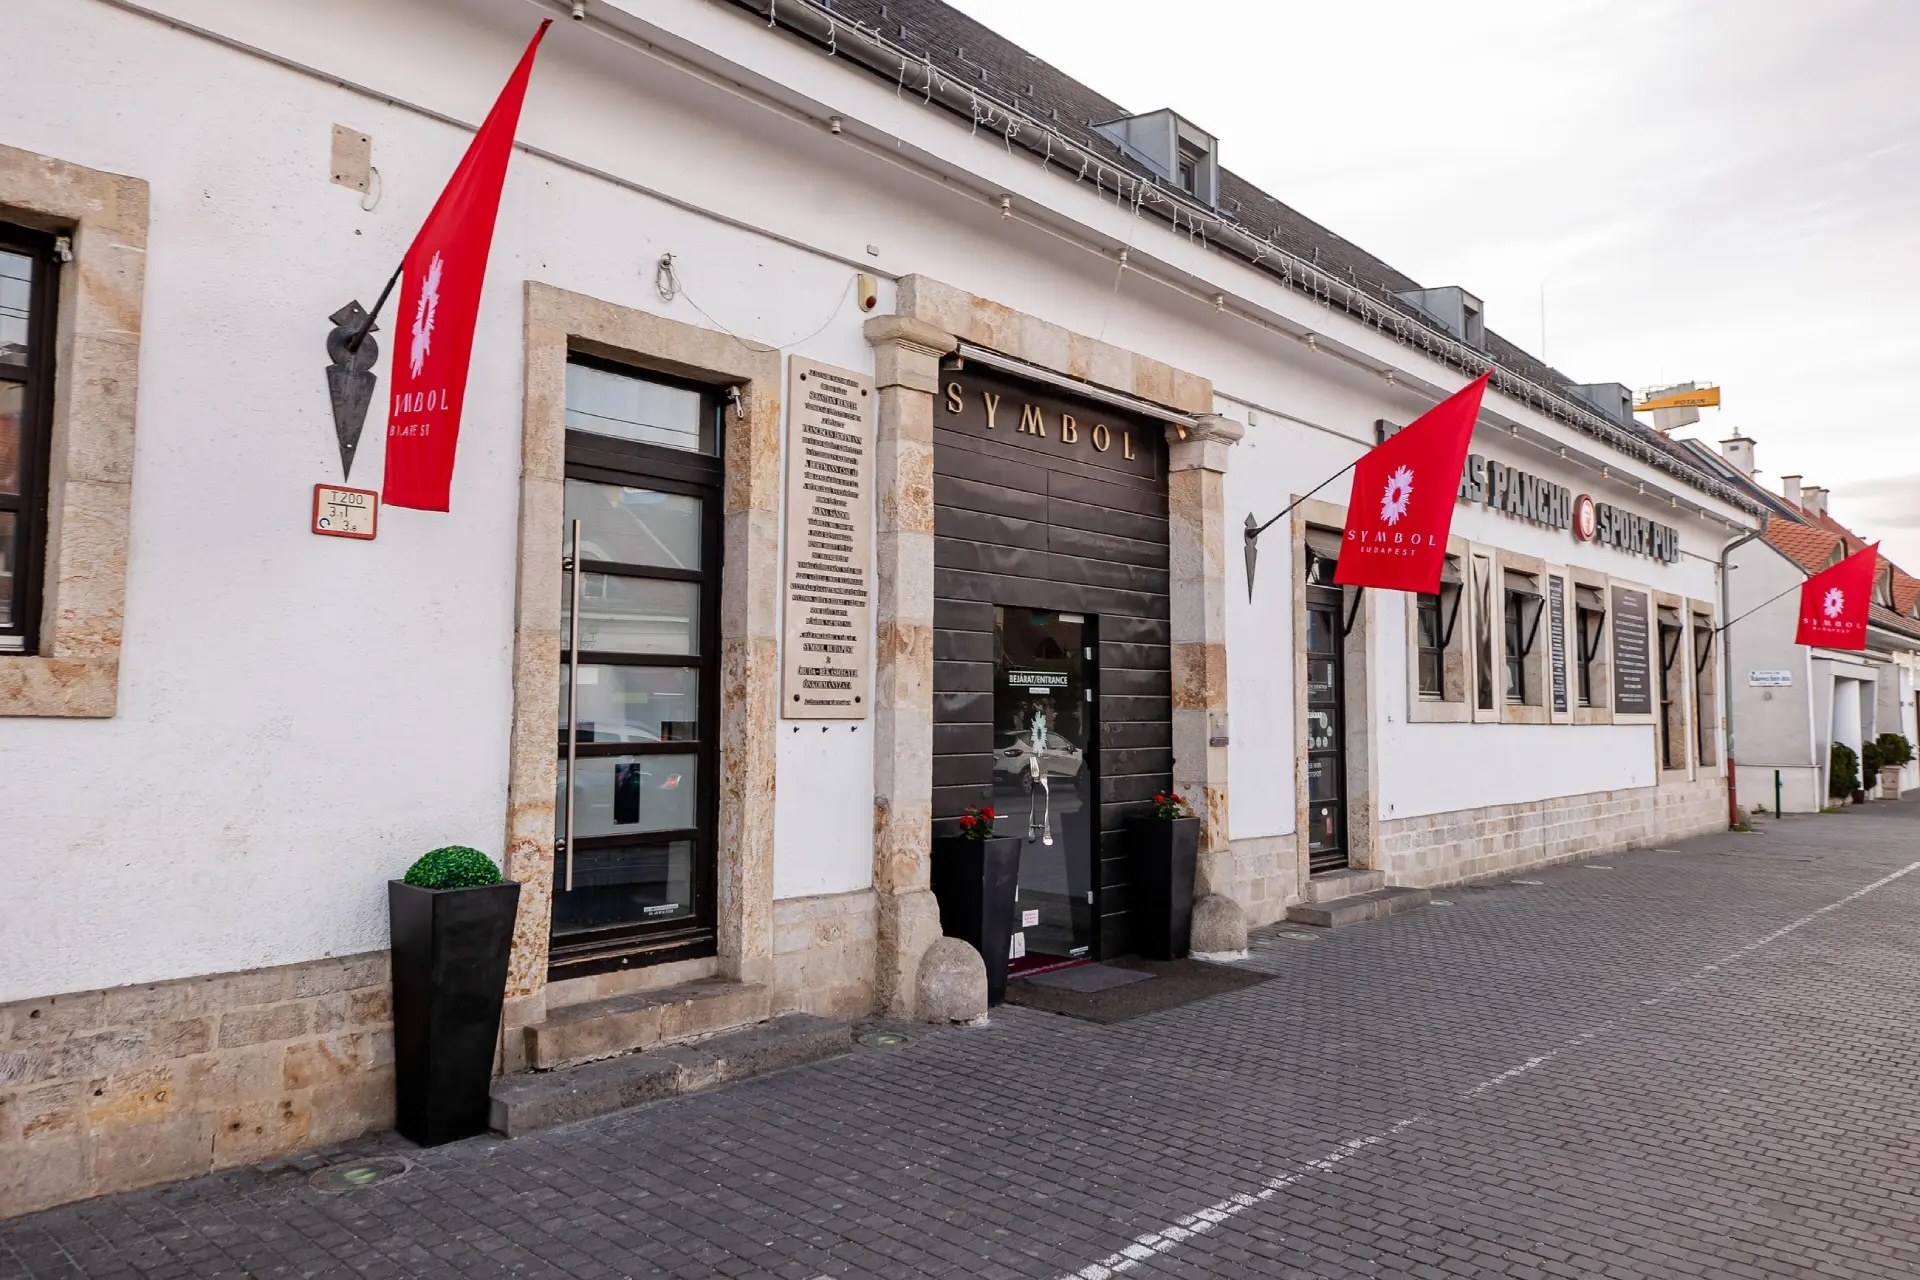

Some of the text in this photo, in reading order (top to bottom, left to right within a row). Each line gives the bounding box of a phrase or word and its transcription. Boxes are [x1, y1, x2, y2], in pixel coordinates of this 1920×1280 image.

[946, 382, 1136, 461] SYMBOL
[1487, 460, 1572, 530] PANCHO
[1595, 502, 1651, 555] SPORT
[1650, 520, 1680, 563] PUB
[1347, 529, 1437, 546] SYMBOL
[1360, 546, 1416, 556] BUDAPEST
[1802, 617, 1862, 630] SYMBOL
[1008, 672, 1068, 685] BEJÁRAT/ENTRANCE
